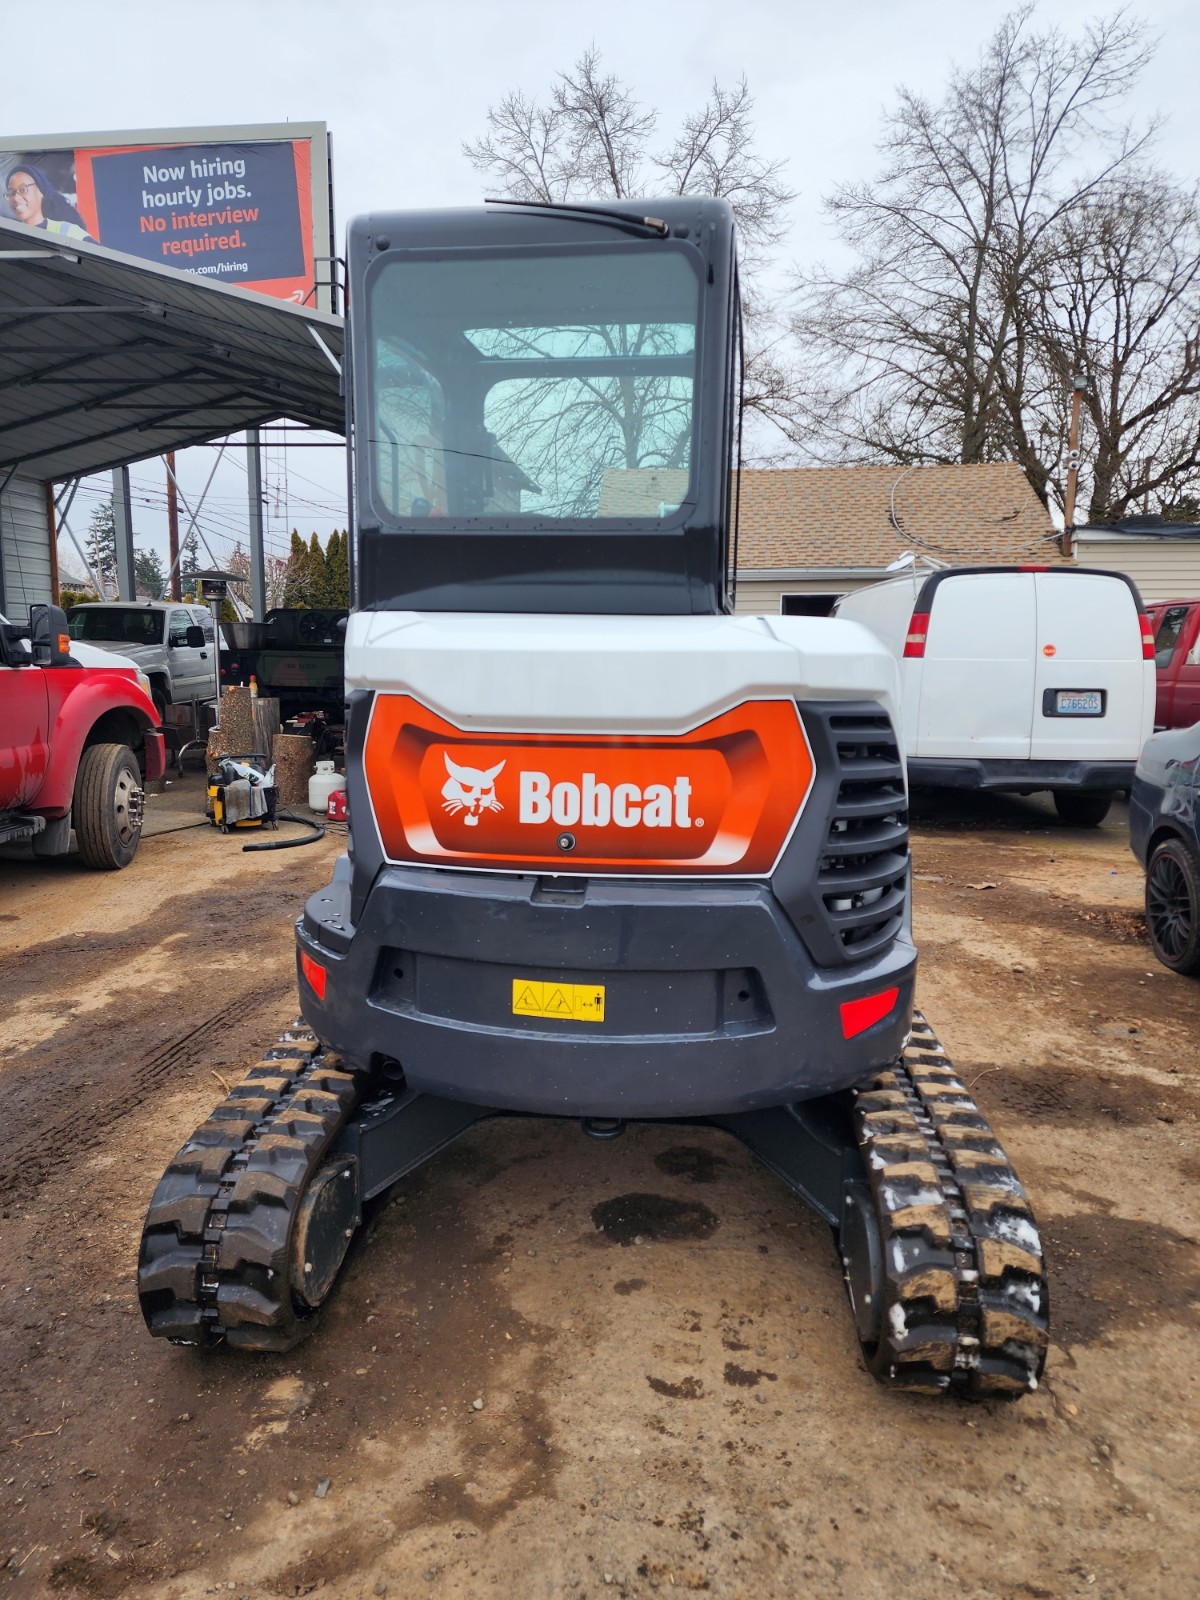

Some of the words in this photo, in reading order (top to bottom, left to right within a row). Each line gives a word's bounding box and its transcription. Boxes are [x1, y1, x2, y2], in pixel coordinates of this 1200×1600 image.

[143, 165, 185, 184] Now
[190, 157, 246, 179] hiring
[141, 185, 202, 208] hourly
[206, 181, 252, 206] jobs.
[140, 215, 167, 233] No
[171, 205, 259, 230] interview
[162, 229, 247, 257] required.
[519, 771, 692, 828] Bobcat
